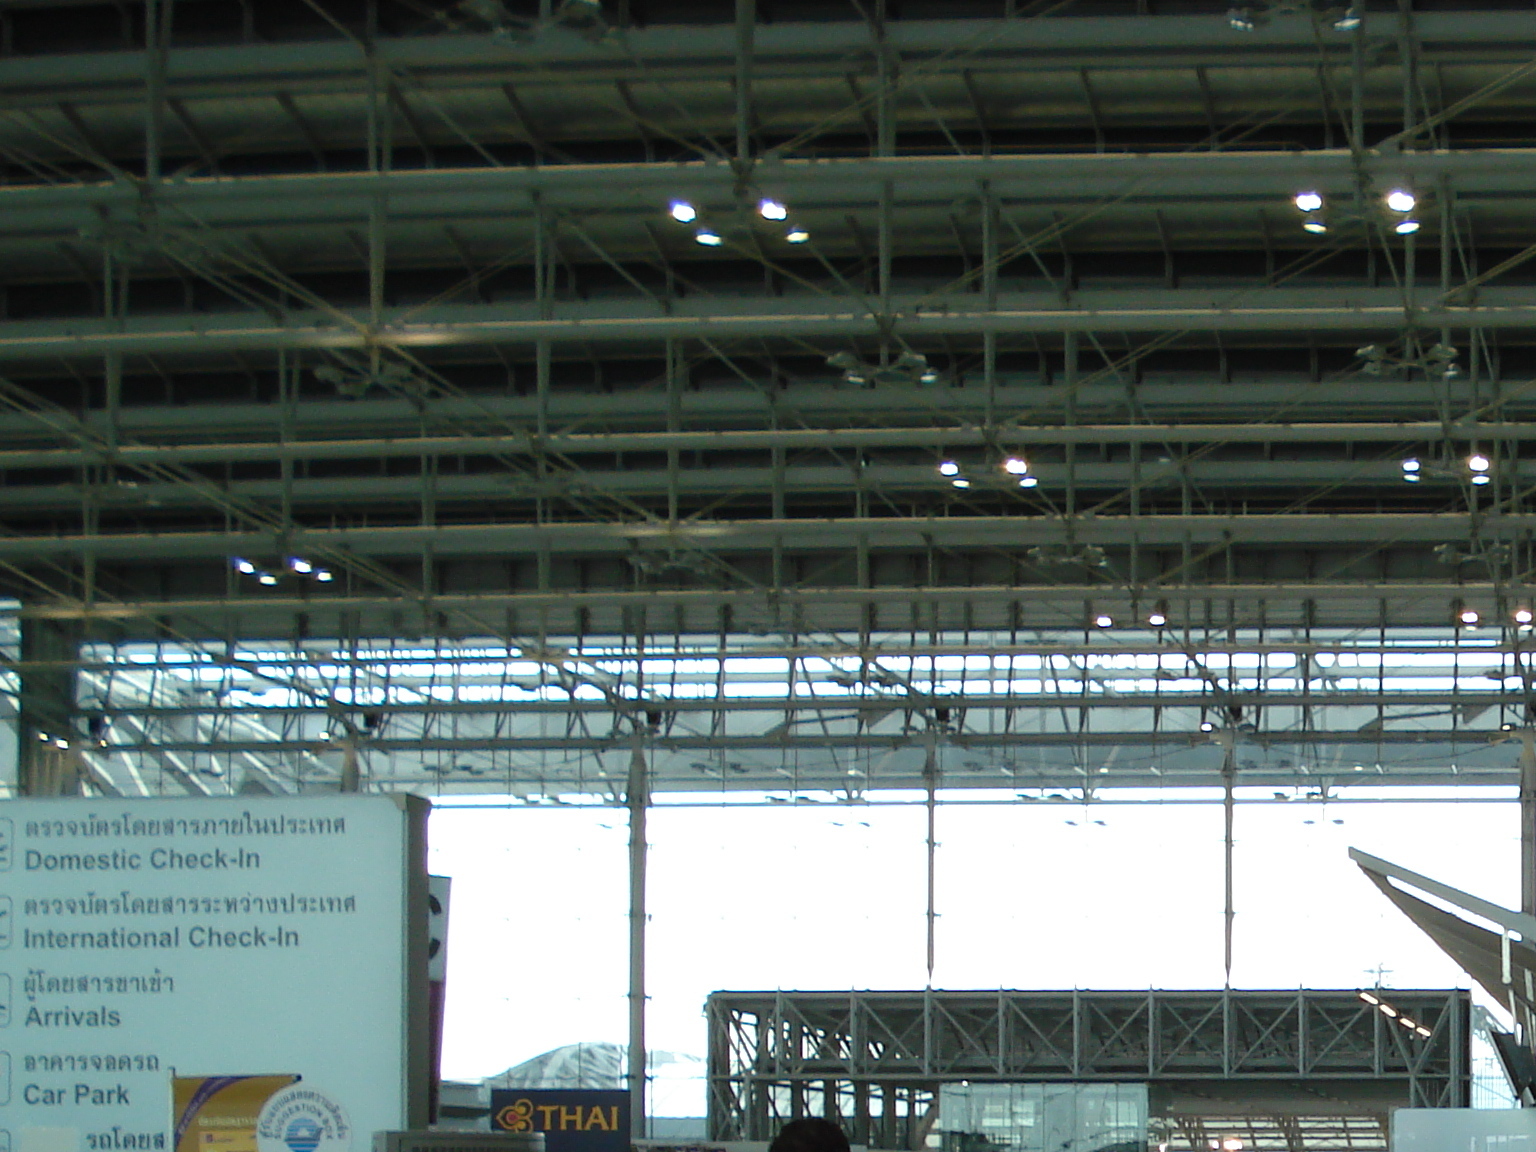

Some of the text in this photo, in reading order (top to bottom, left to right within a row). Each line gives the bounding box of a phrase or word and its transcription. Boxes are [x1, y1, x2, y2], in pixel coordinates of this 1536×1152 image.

[25, 811, 346, 837] ตรวจบัตรโดยสารภายในประเทศ
[25, 848, 261, 871] Domestic Check-In
[24, 892, 356, 916] ตรวจบัตรโดยสารระหว่างประเทศ
[24, 926, 299, 949] International Check-In
[24, 968, 175, 1001] ผู้โดยสารขาเข้า
[25, 1006, 121, 1027] Arrivals
[24, 1054, 159, 1072] อาคารจอดรถ
[23, 1084, 130, 1106] Car Park
[536, 1105, 619, 1131] THAI
[86, 1126, 165, 1150] รถโดยส
